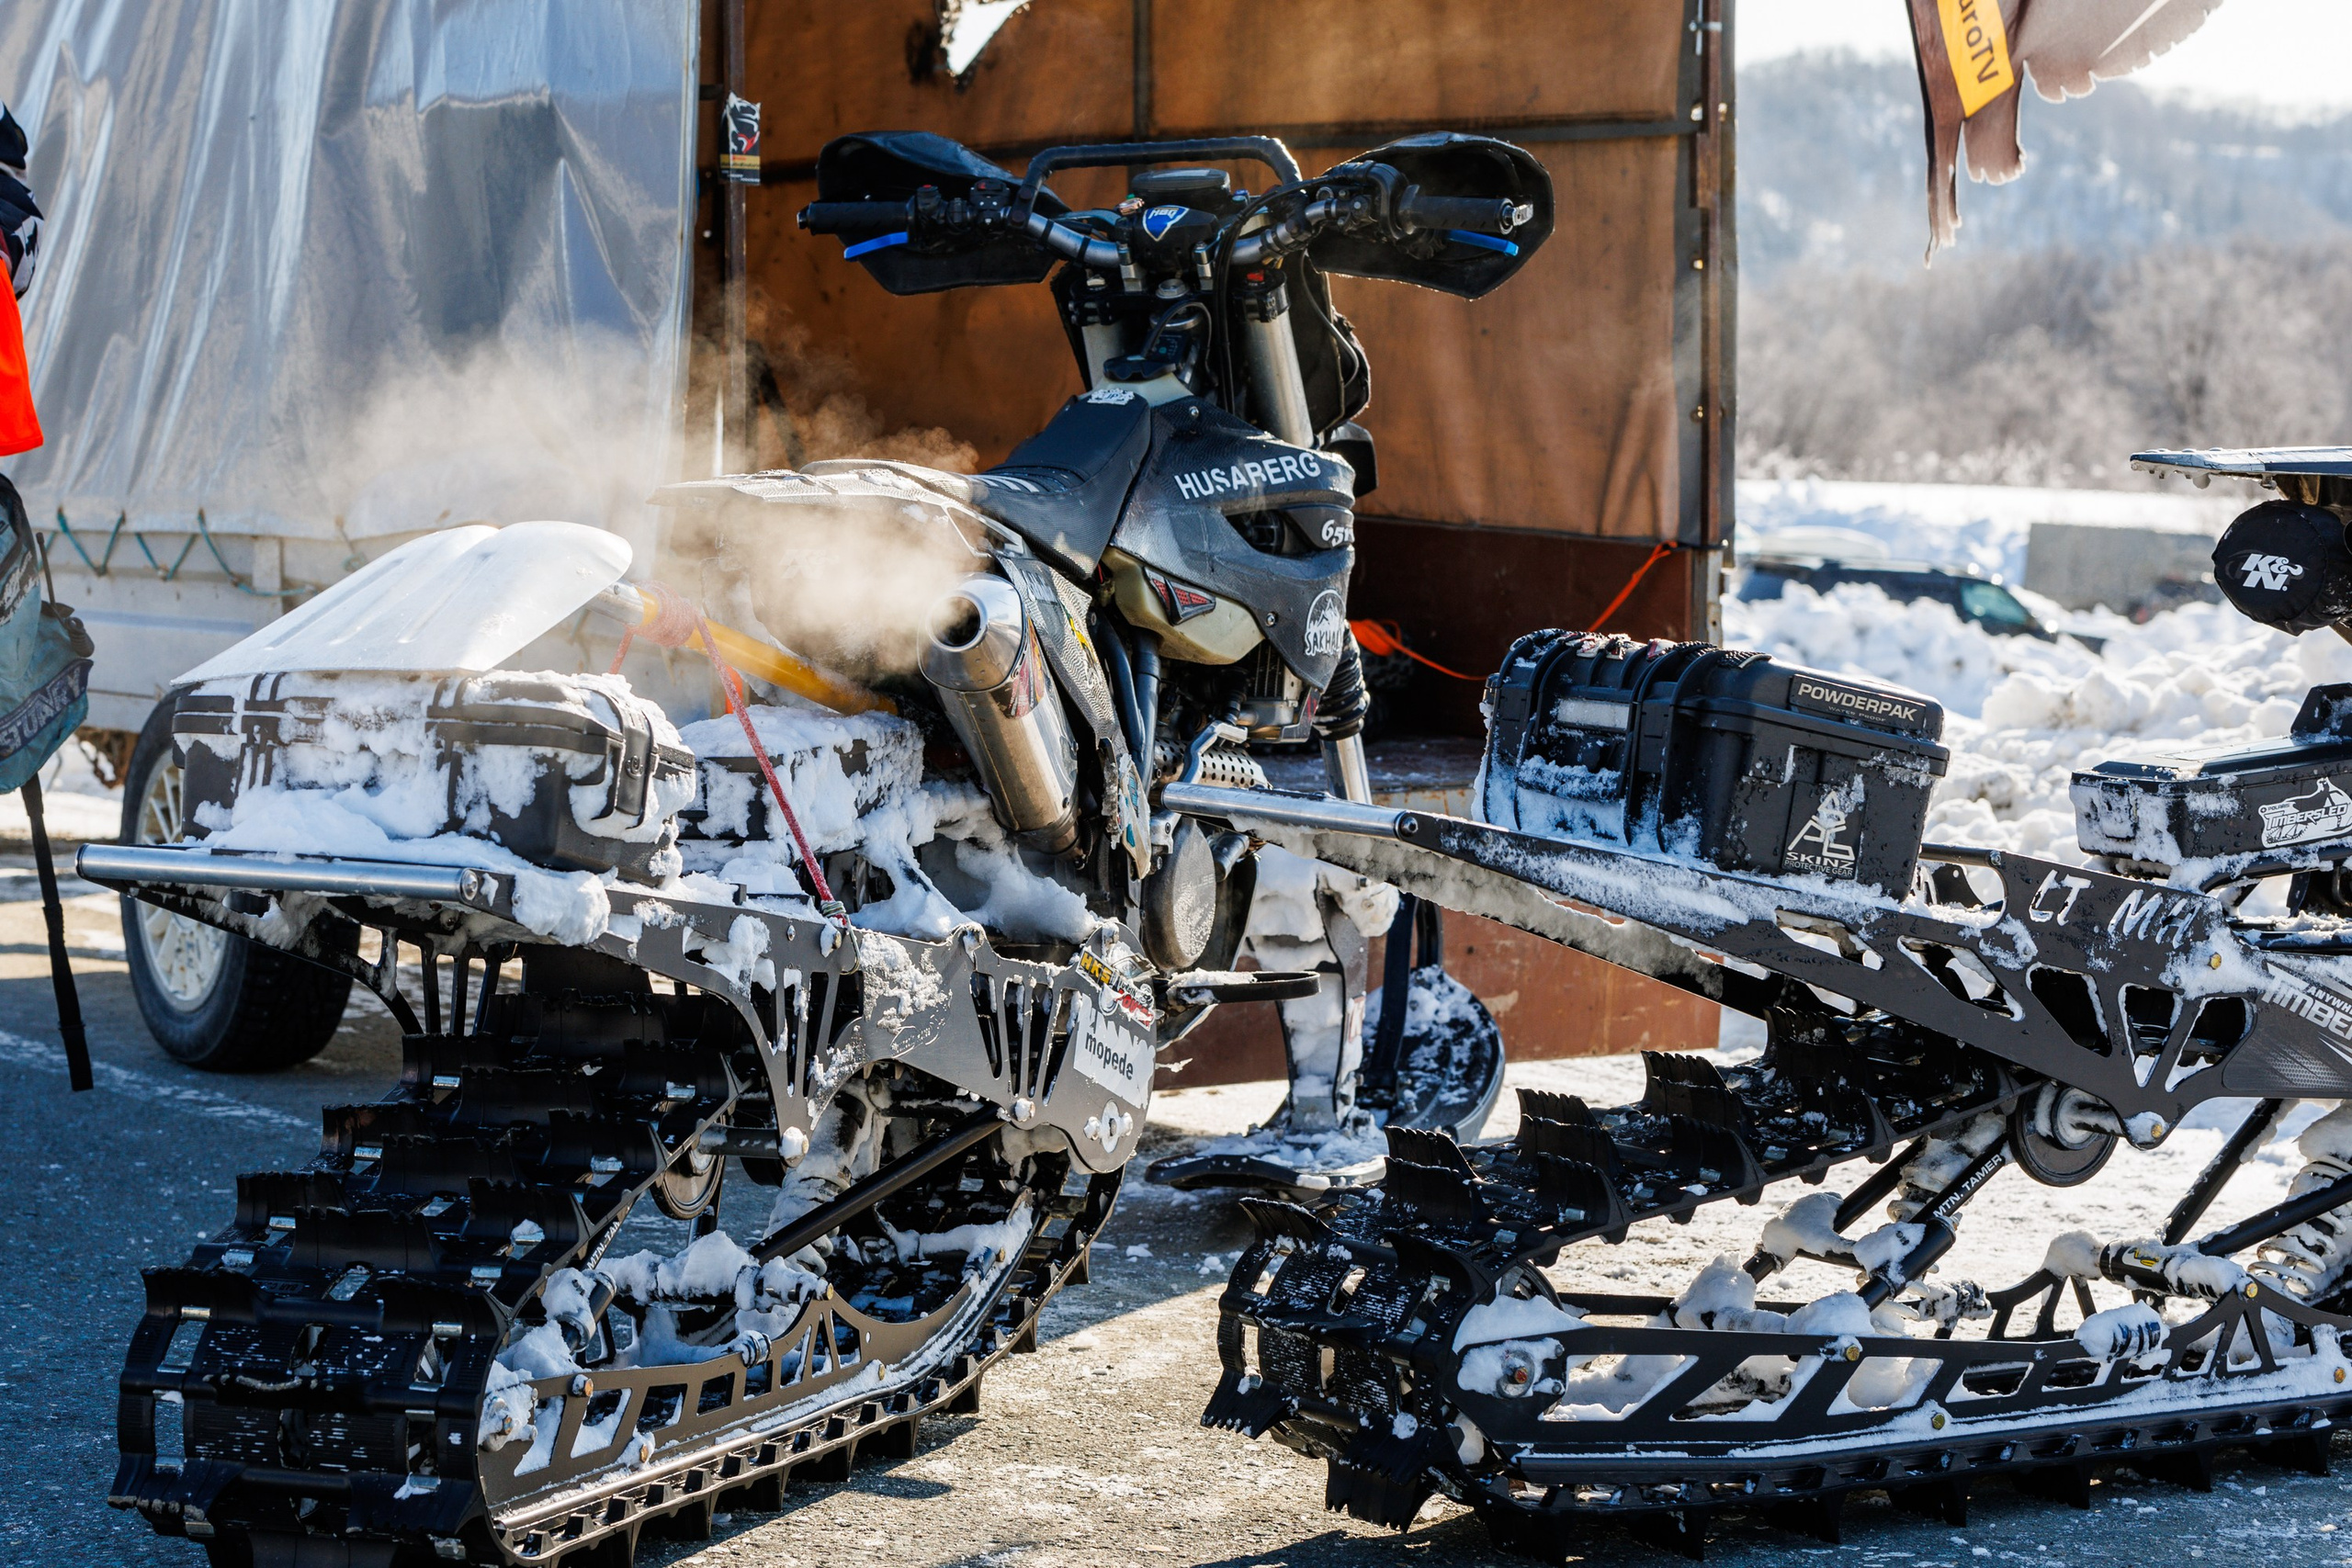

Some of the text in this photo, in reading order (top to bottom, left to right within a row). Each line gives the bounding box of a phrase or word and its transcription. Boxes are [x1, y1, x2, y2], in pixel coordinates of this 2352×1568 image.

[1174, 452, 1321, 500] HUSABERG
[2241, 553, 2303, 591] K&N
[1797, 682, 1918, 722] POWDERPAK
[1828, 705, 1886, 722] WATER PROOF
[2264, 802, 2349, 831] TIMBERSLED
[1784, 860, 1853, 877] PROTECTIVE GEAR
[1785, 852, 1855, 871] SKINZ
[1080, 952, 1113, 985] HKS
[1084, 1032, 1135, 1080] mopede
[1933, 1154, 2002, 1218] MTN. TAMER
